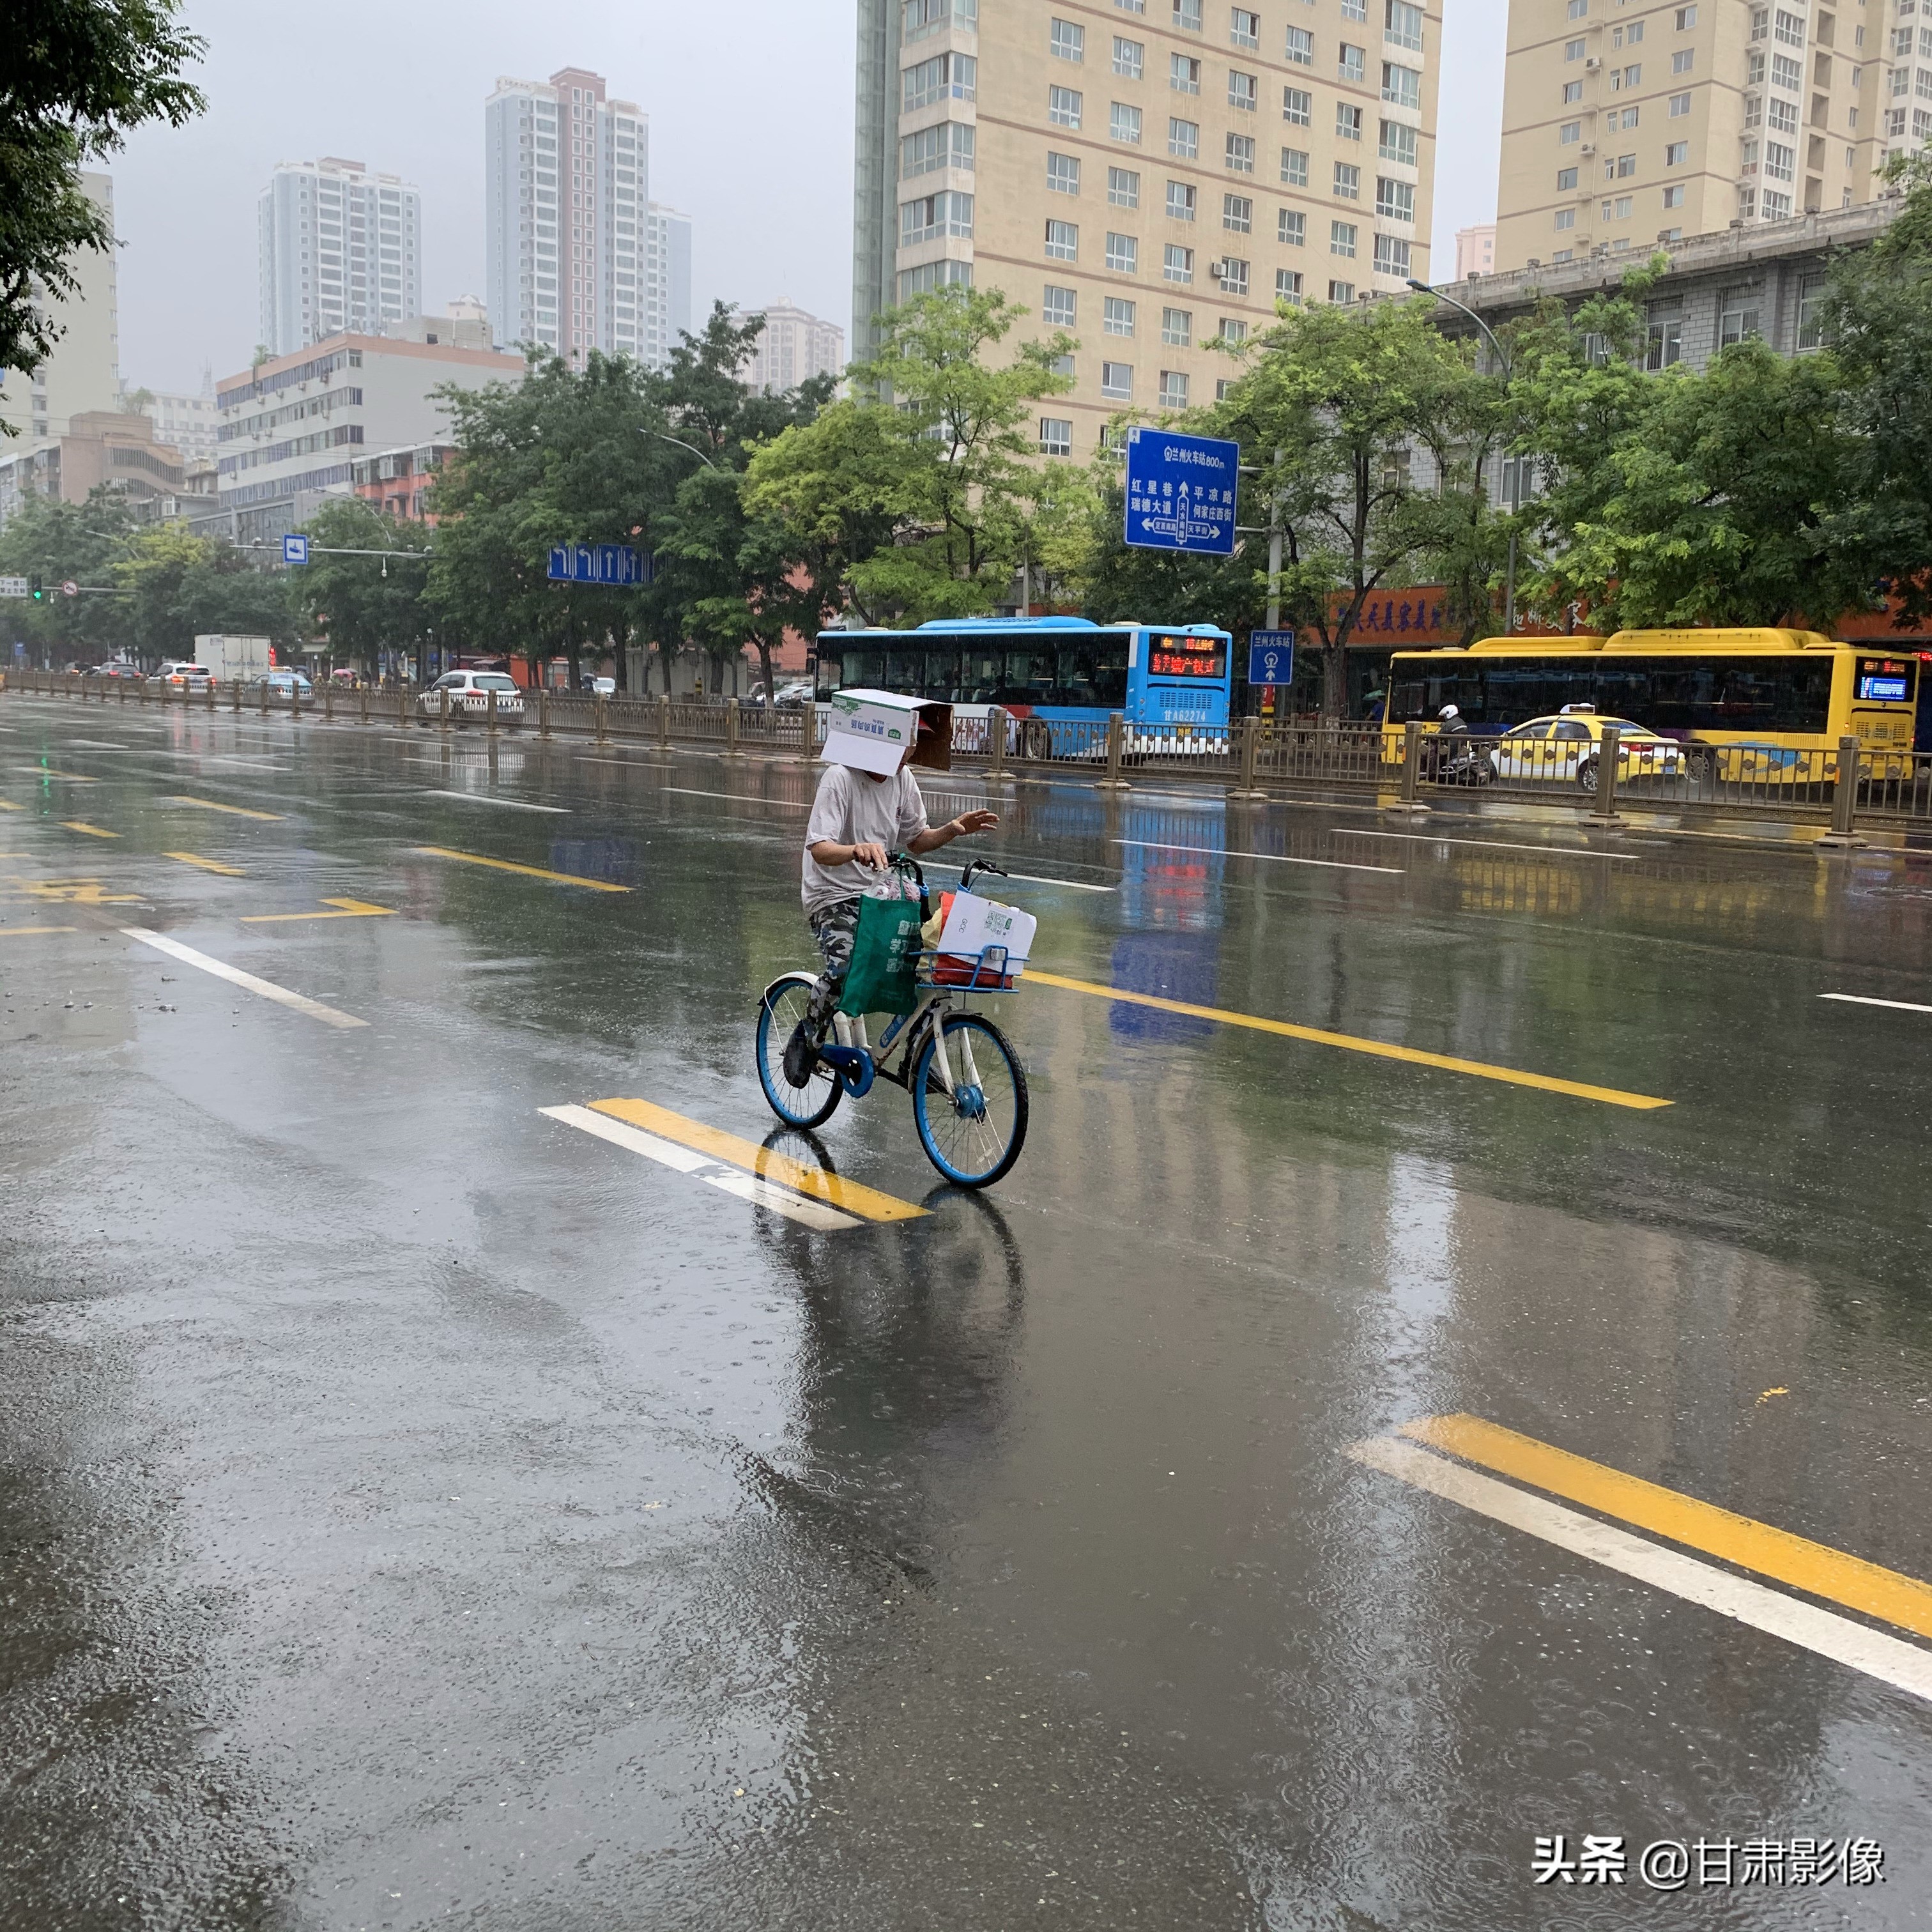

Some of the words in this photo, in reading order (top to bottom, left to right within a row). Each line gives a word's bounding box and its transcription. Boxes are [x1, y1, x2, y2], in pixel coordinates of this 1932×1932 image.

[1172, 447, 1225, 468] 兰州火车站800m
[1131, 478, 1172, 496] 红星巷
[1193, 486, 1232, 505] 平凉路
[1131, 497, 1172, 515] 瑞德大道
[1254, 636, 1290, 648] 兰州火车站
[1164, 710, 1206, 722] 甘A62274
[958, 918, 968, 933] GCC
